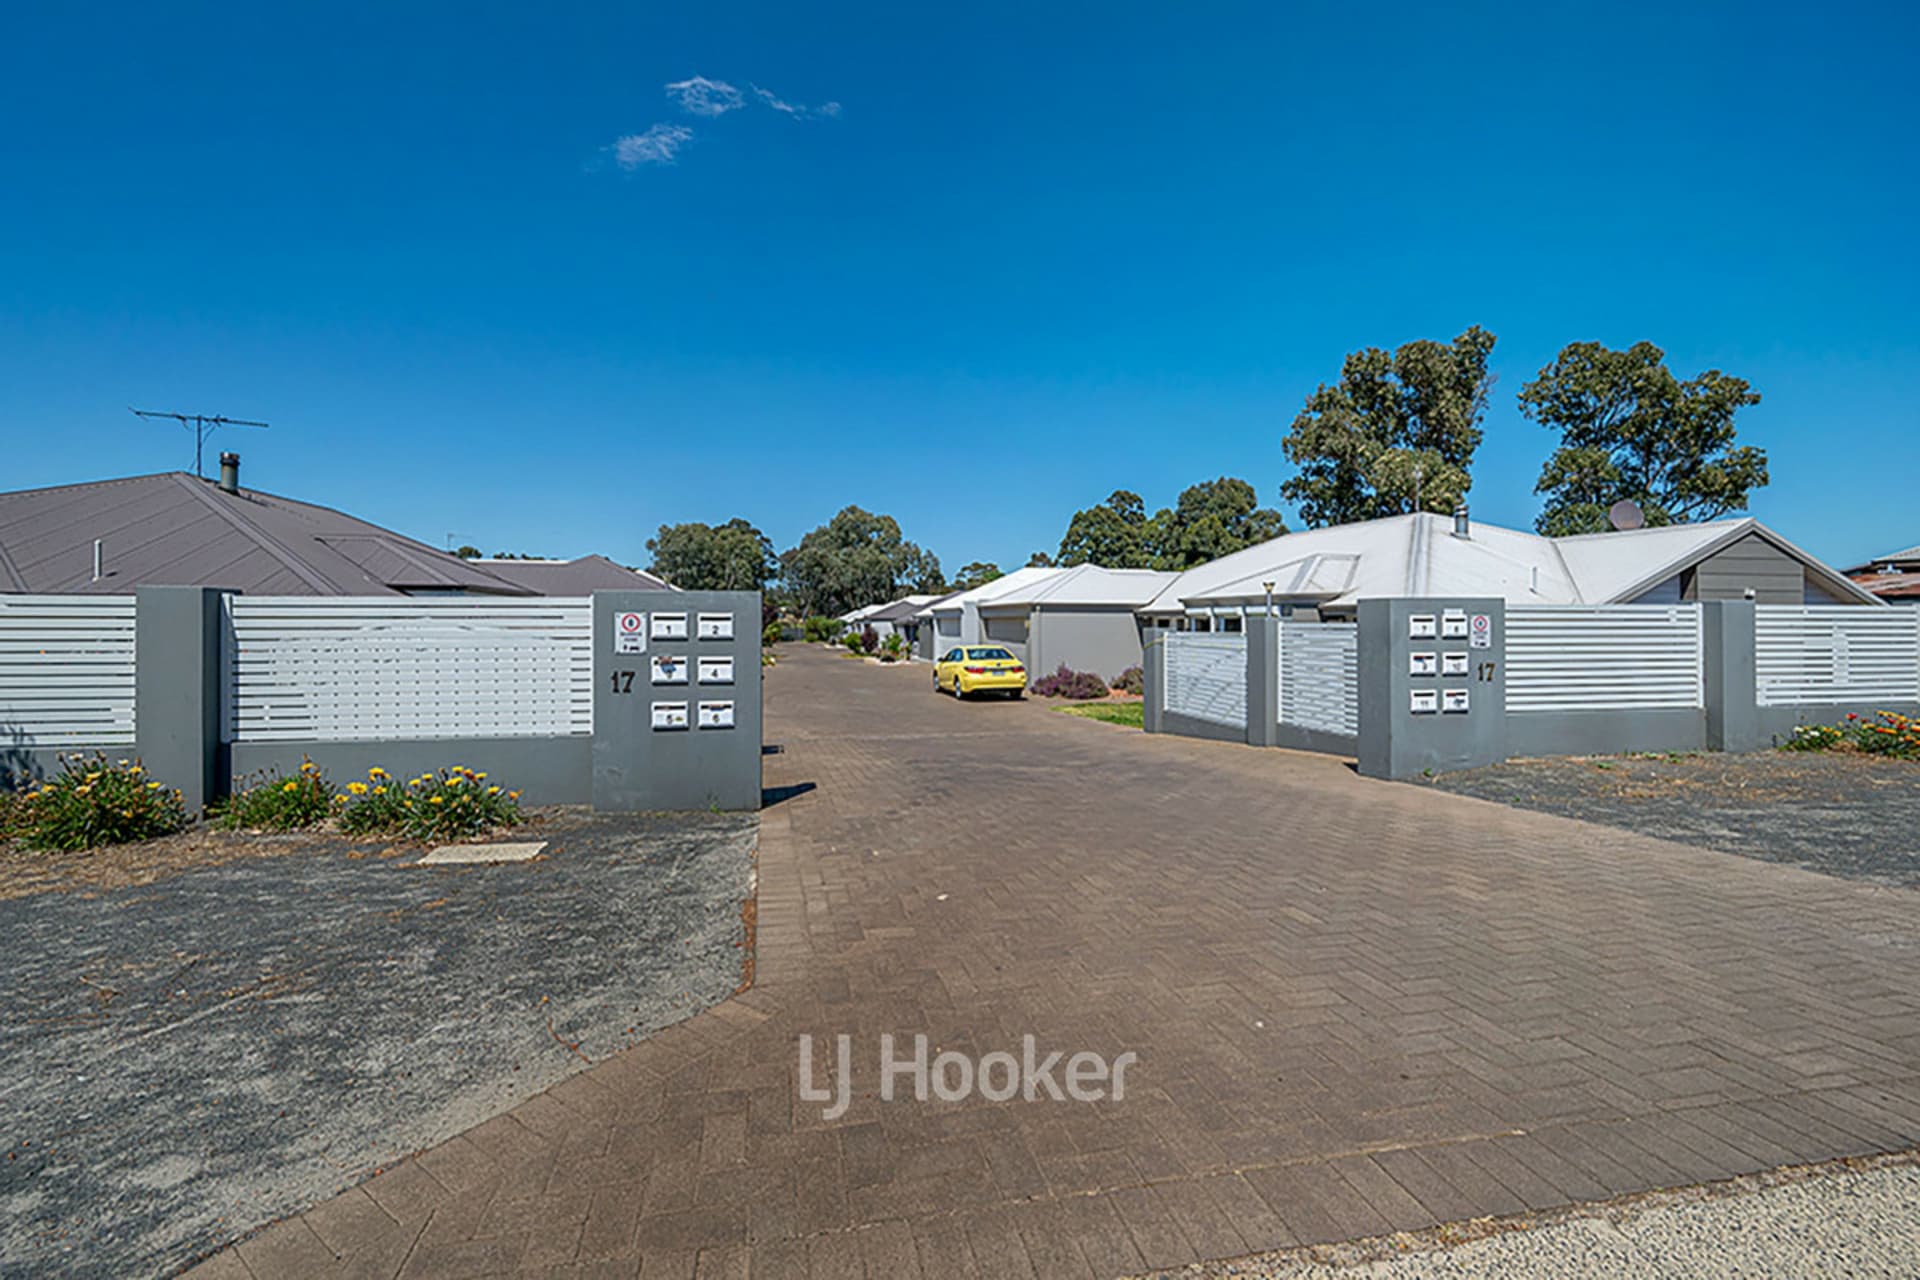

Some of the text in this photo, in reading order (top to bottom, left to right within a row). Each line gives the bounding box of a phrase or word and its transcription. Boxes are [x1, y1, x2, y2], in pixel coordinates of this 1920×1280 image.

[665, 625, 672, 635] 1
[711, 625, 720, 636] 2
[711, 668, 718, 678] 4
[1477, 662, 1496, 682] 17
[611, 671, 635, 694] 17
